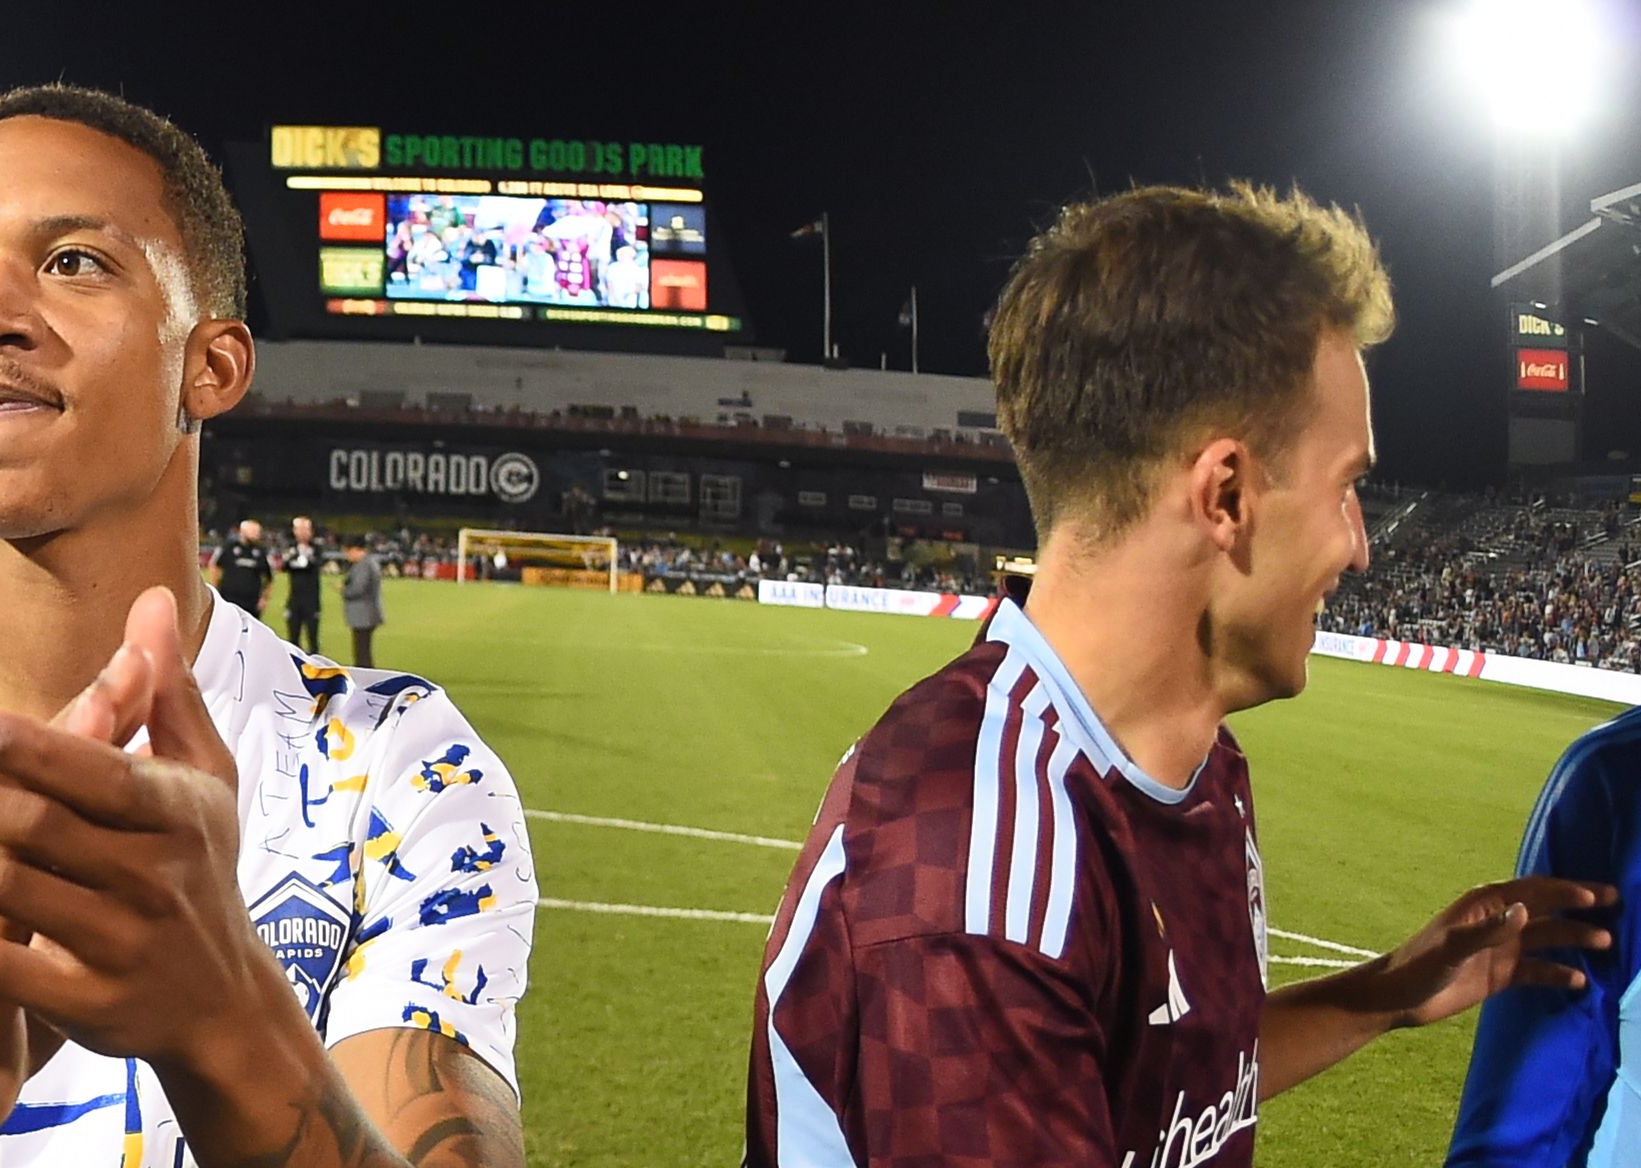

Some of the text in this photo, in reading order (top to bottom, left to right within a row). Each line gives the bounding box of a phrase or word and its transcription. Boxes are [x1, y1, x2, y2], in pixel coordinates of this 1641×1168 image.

[385, 134, 523, 170] SPORTING
[629, 144, 704, 178] PARK
[329, 449, 488, 495] COLORADO
[275, 948, 324, 959] APIDS
